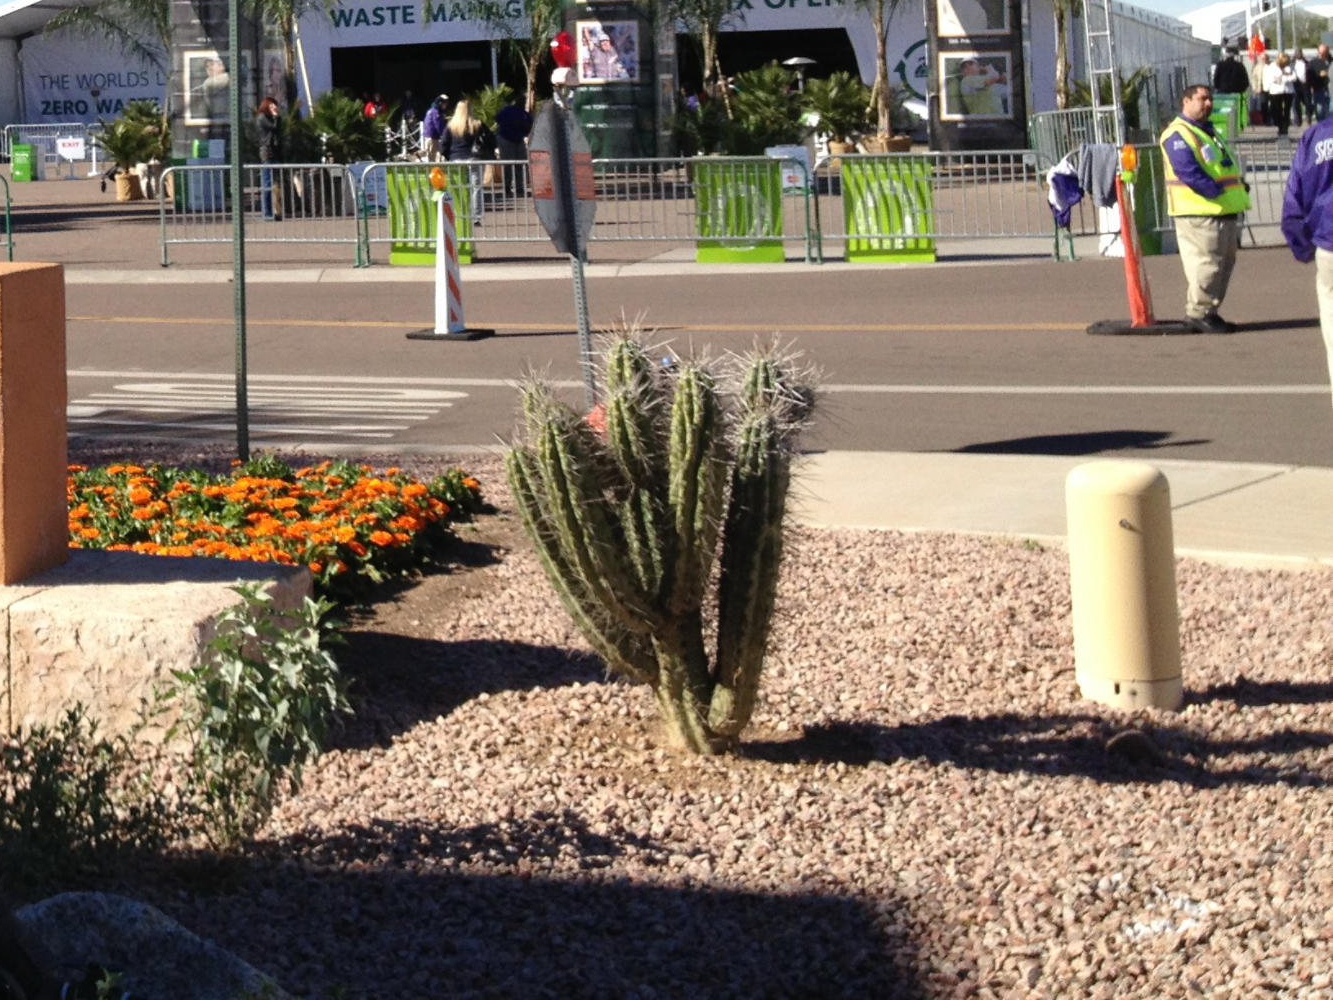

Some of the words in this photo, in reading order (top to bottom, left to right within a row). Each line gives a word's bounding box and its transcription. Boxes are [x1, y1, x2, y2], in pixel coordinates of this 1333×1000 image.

[330, 4, 414, 28] WASTE
[40, 73, 70, 90] THE
[77, 71, 149, 90] WORLDS
[41, 100, 88, 116] ZERO
